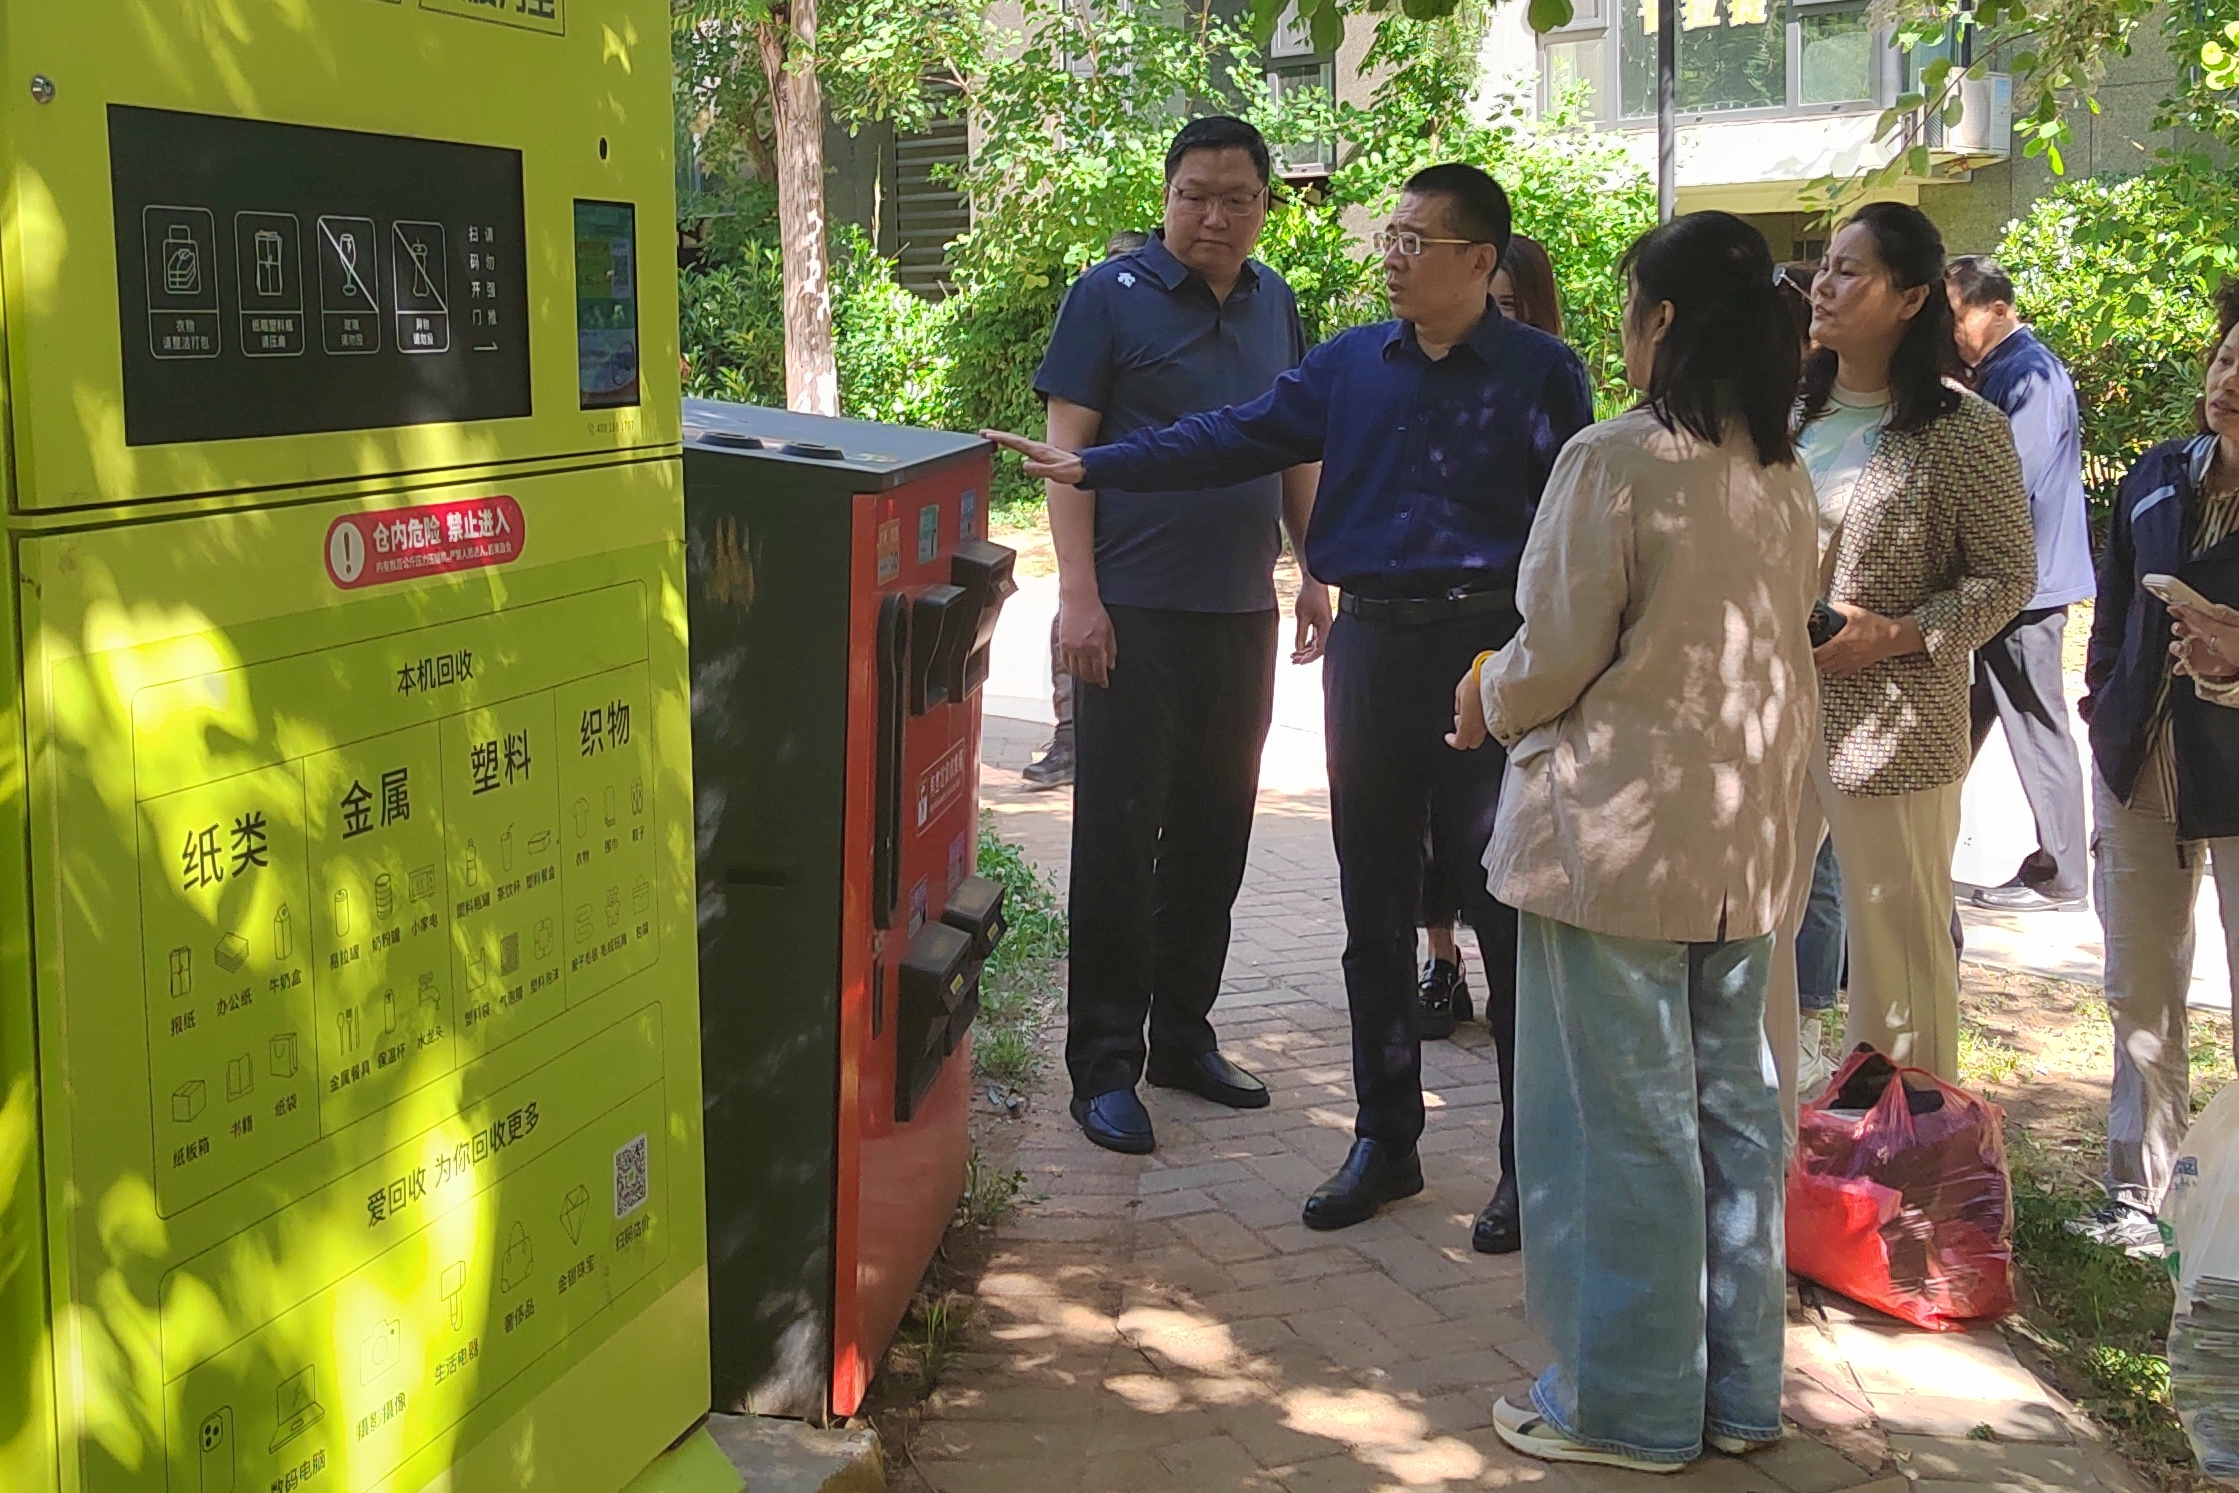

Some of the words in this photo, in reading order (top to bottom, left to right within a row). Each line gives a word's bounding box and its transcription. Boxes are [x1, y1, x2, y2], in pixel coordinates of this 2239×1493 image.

[373, 515, 441, 553] 仓内危险
[446, 506, 511, 543] 禁止进入
[397, 649, 473, 697] 本机回收
[580, 699, 630, 757] 织物
[471, 728, 531, 795] 塑料
[340, 767, 409, 840] 金属
[182, 811, 268, 891] 纸类
[372, 927, 400, 953] 奶粉罐
[412, 913, 439, 937] 小家电
[330, 944, 360, 970] 易拉罐
[269, 969, 302, 995] 牛奶盒
[217, 987, 253, 1017] 办公纸
[171, 1010, 196, 1037] 报纸
[417, 1025, 444, 1050] 水龙头
[378, 1042, 406, 1070] 保温杯
[330, 1059, 371, 1093] 金属餐具
[274, 1093, 298, 1117] 纸袋
[230, 1114, 253, 1139] 书籍
[173, 1136, 210, 1168] 纸板箱
[367, 1166, 427, 1230] 爱回收
[434, 1101, 540, 1189] 为你回收更多
[558, 1253, 596, 1296] 金银珠宝
[504, 1297, 536, 1335] 奢侈品
[434, 1337, 479, 1387] 生活电器
[356, 1391, 407, 1443] 摄影摄像
